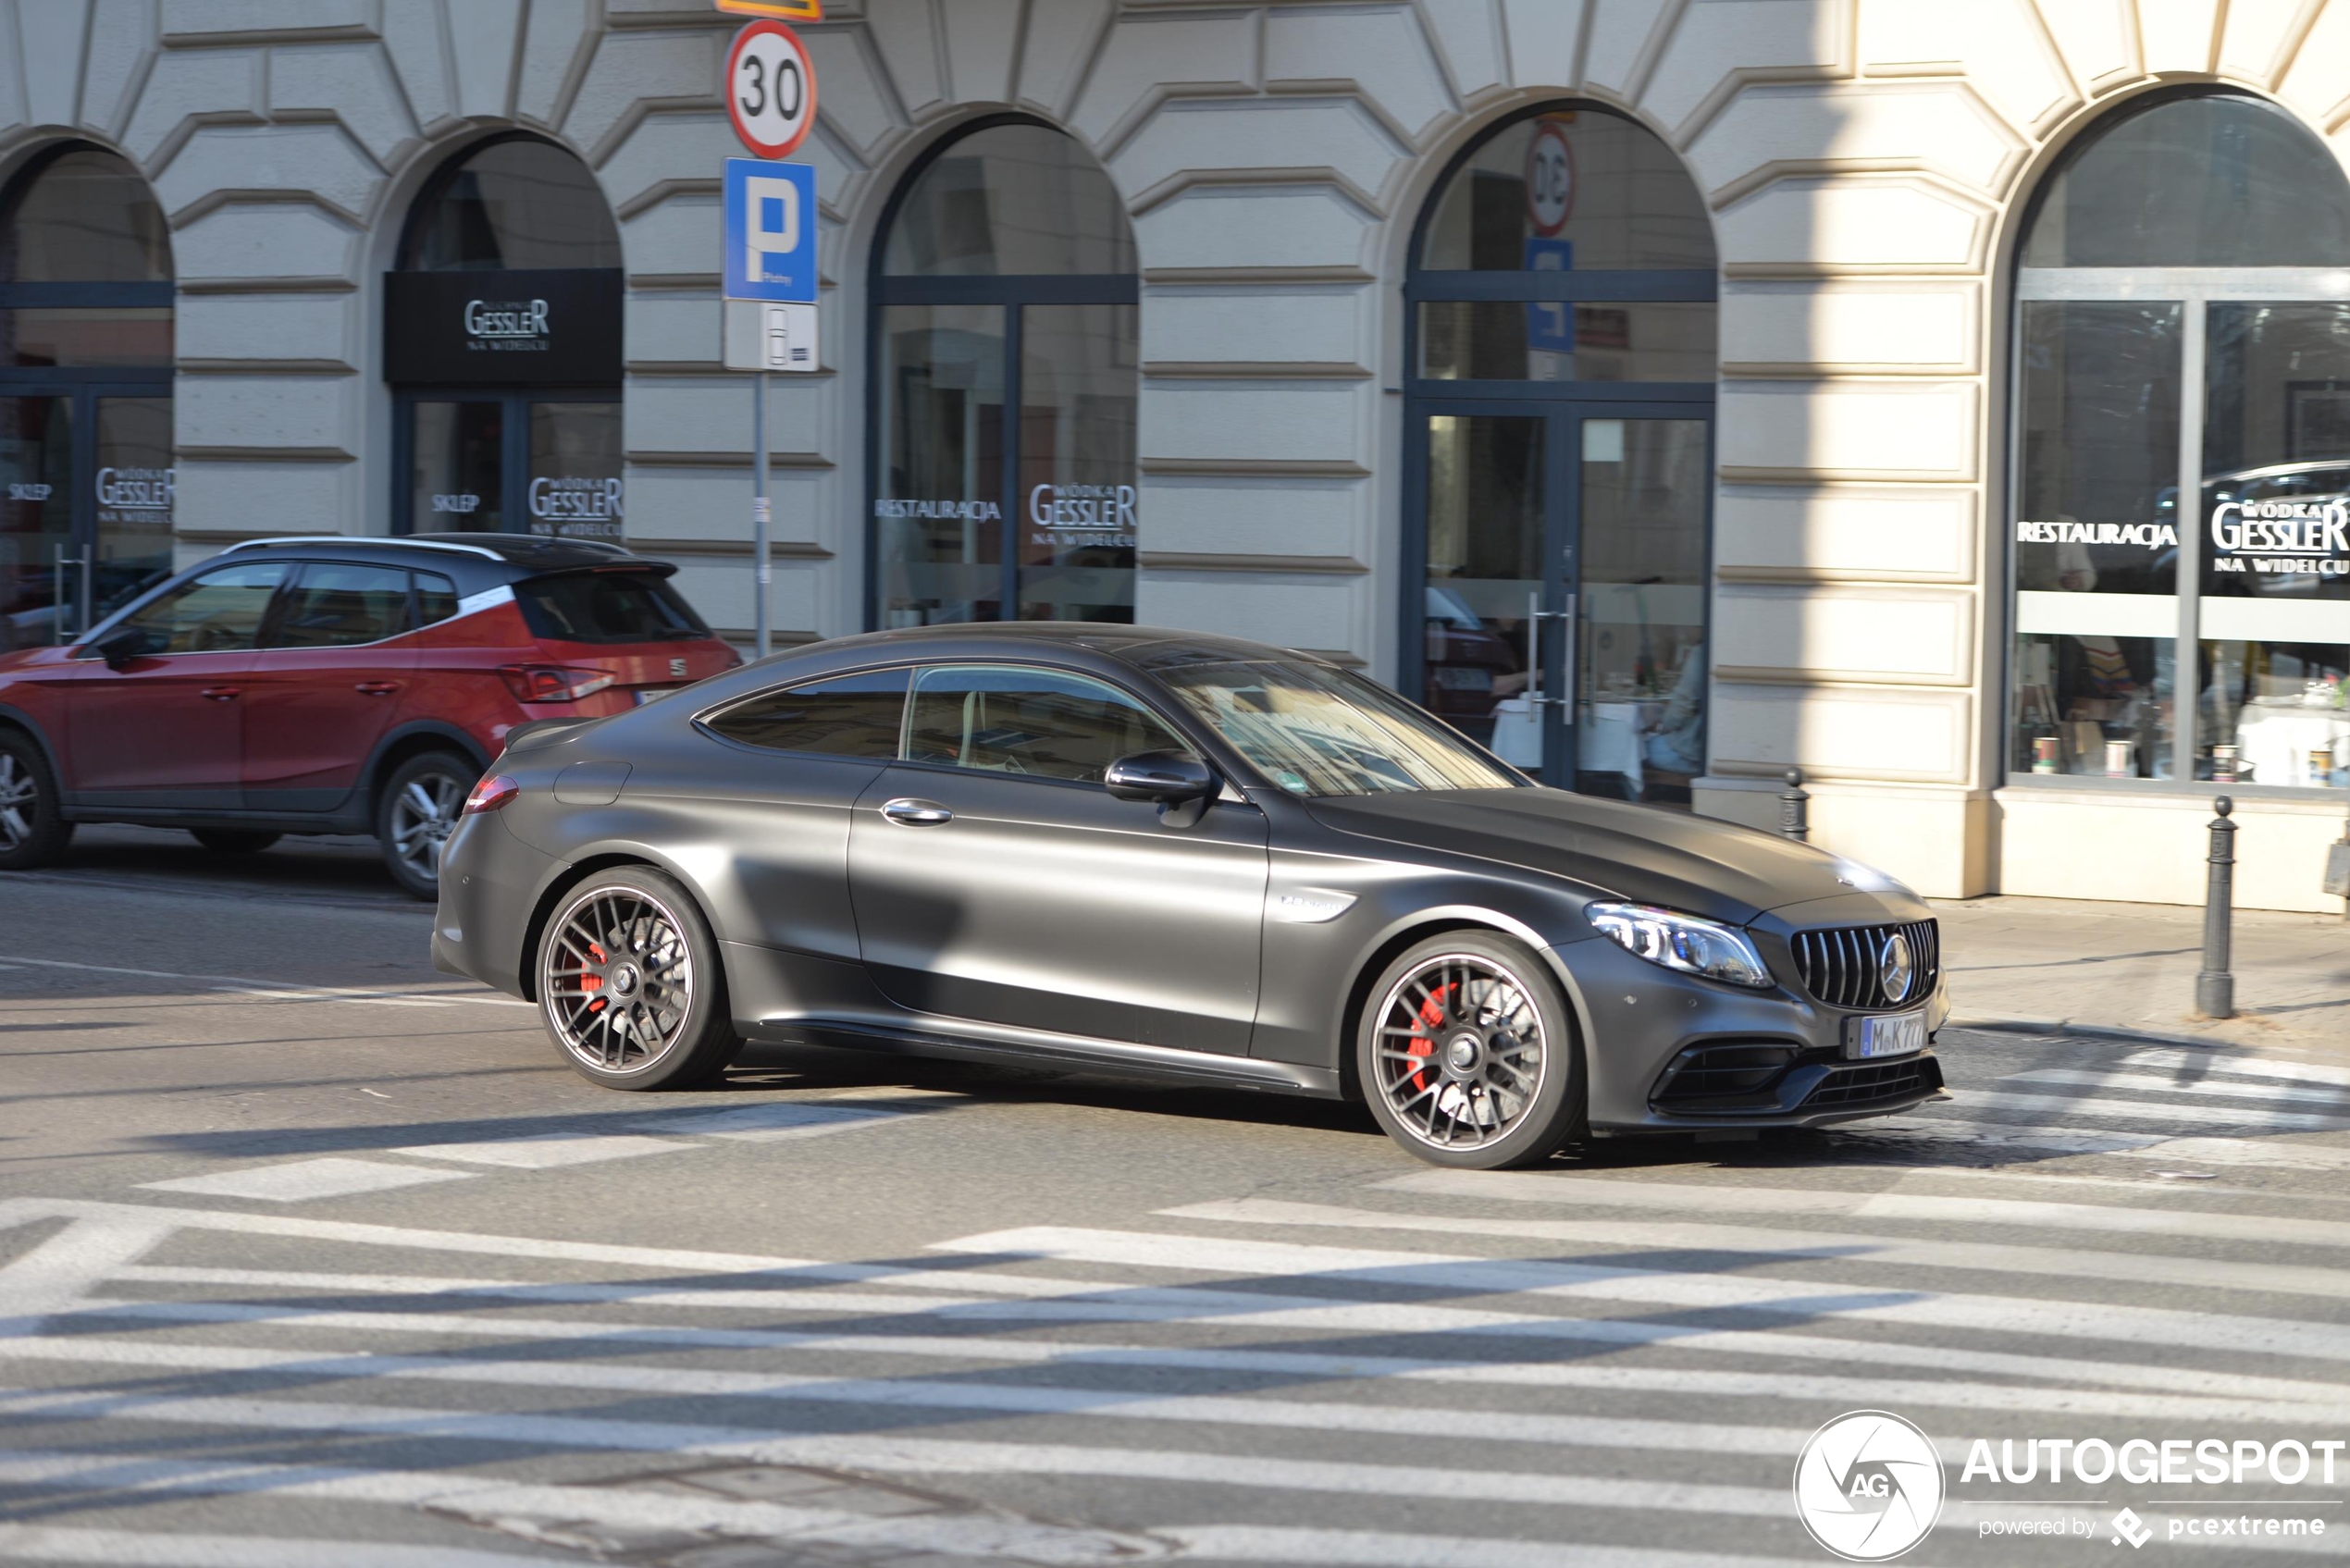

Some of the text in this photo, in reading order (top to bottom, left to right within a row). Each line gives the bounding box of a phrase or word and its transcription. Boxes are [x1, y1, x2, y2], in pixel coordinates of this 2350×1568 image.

[739, 55, 802, 121] 30
[746, 176, 800, 282] P
[464, 299, 550, 335] GESSLER
[8, 484, 53, 500] SKLEP
[431, 494, 480, 512] SKLEP
[528, 477, 625, 516] GESSLER
[1030, 483, 1137, 526] GESSLER
[874, 499, 1001, 524] RESTAURACJA
[2240, 500, 2322, 518] WÓDKA
[1032, 534, 1057, 546] NA
[2017, 521, 2179, 550] RESTAURACJA
[2211, 501, 2350, 551] GESSLER
[2214, 558, 2350, 574] NA WIDELCU
